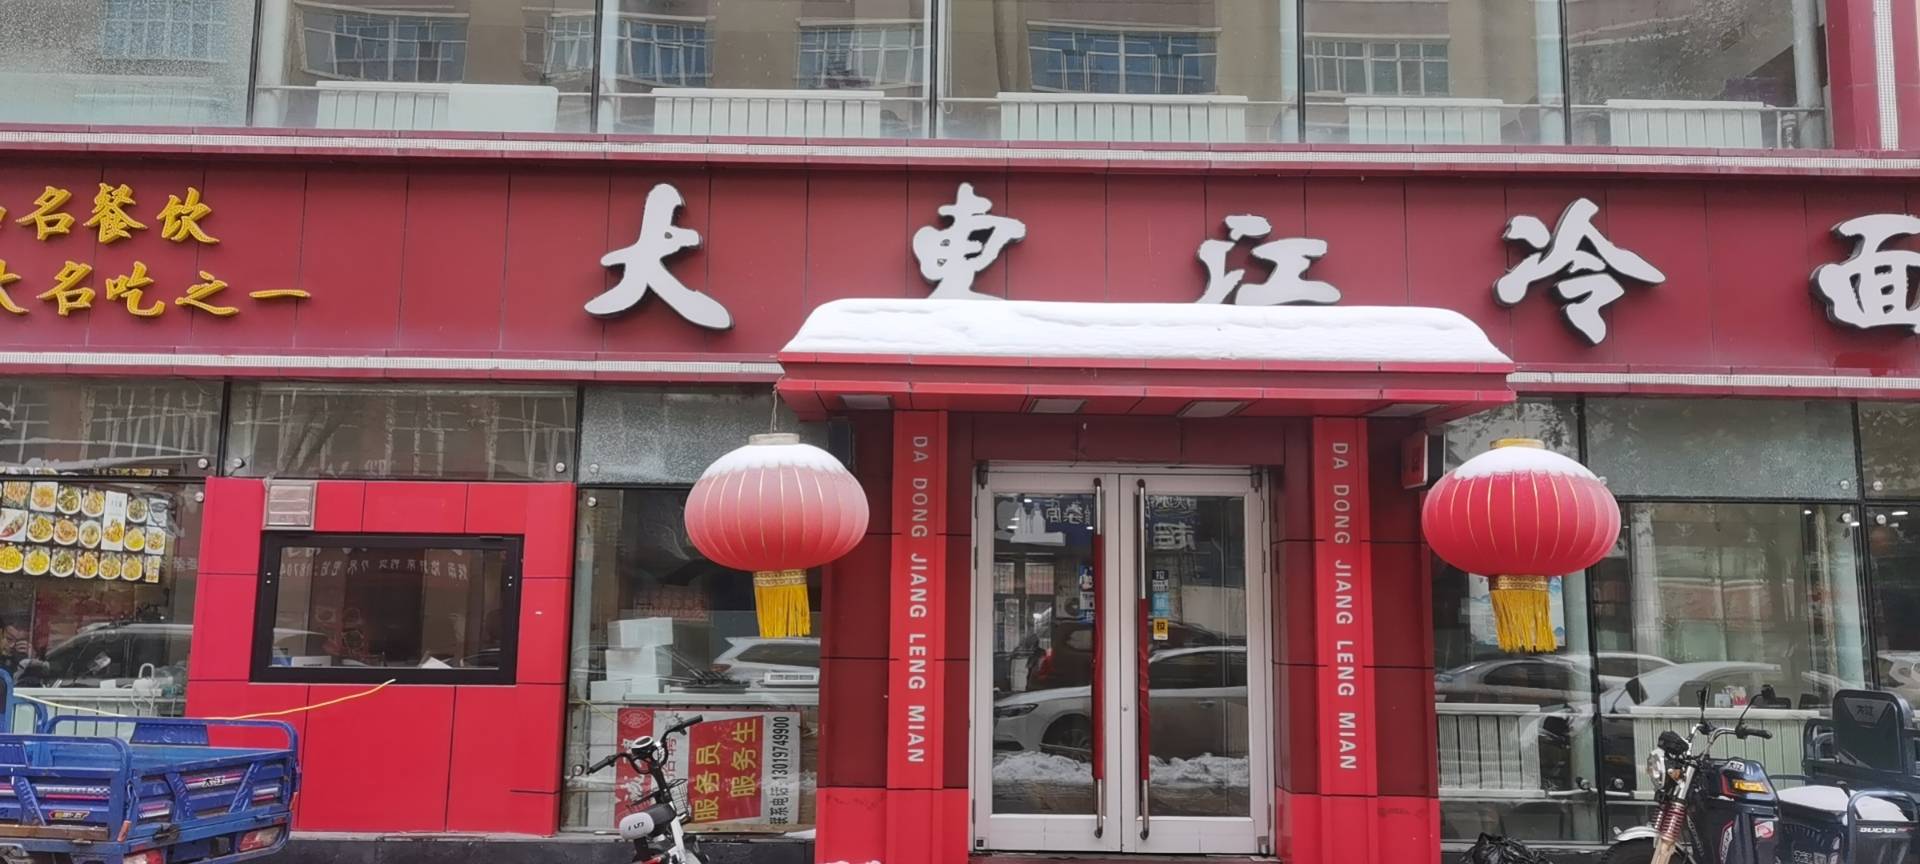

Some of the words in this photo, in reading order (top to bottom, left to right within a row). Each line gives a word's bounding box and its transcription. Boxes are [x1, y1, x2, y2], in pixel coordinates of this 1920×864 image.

[0, 183, 220, 244] 名餐饮
[912, 436, 929, 463] DA
[1332, 442, 1349, 469] DA
[911, 478, 929, 537] DONG
[1333, 484, 1350, 544] DONG
[909, 552, 928, 618] JIANG
[1335, 559, 1353, 625] JIANG
[908, 633, 927, 690] LENG
[1336, 640, 1356, 697] LENG
[730, 718, 757, 798] 服务生
[907, 705, 926, 763] MIAN
[1338, 712, 1358, 770] MIAN
[694, 742, 721, 821] 服务员
